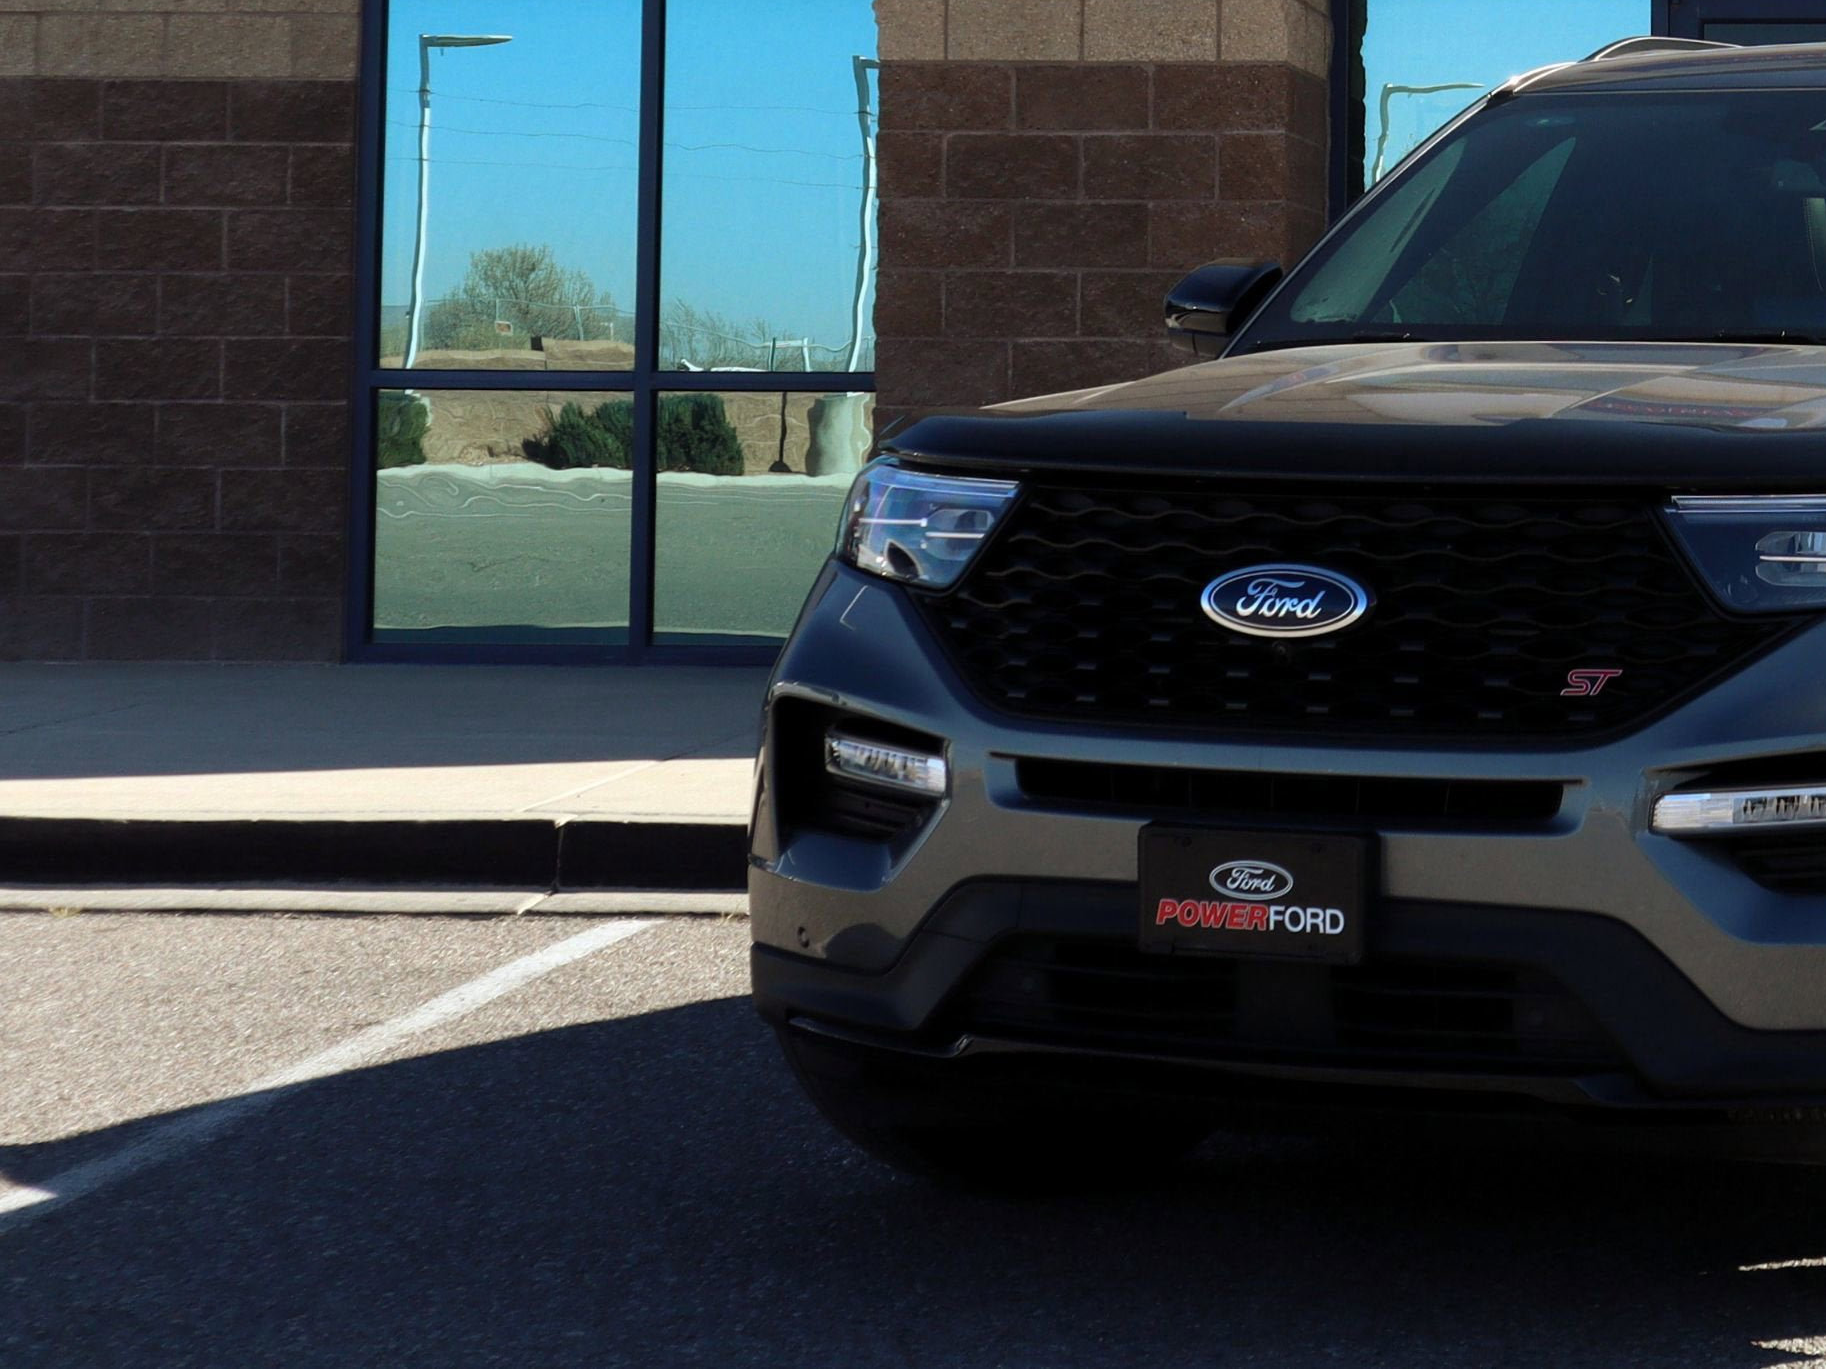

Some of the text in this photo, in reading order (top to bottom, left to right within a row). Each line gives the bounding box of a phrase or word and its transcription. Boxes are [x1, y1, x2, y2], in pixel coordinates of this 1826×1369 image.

[1237, 578, 1326, 620] Ford
[1560, 669, 1623, 696] ST
[1226, 867, 1276, 893] Ford
